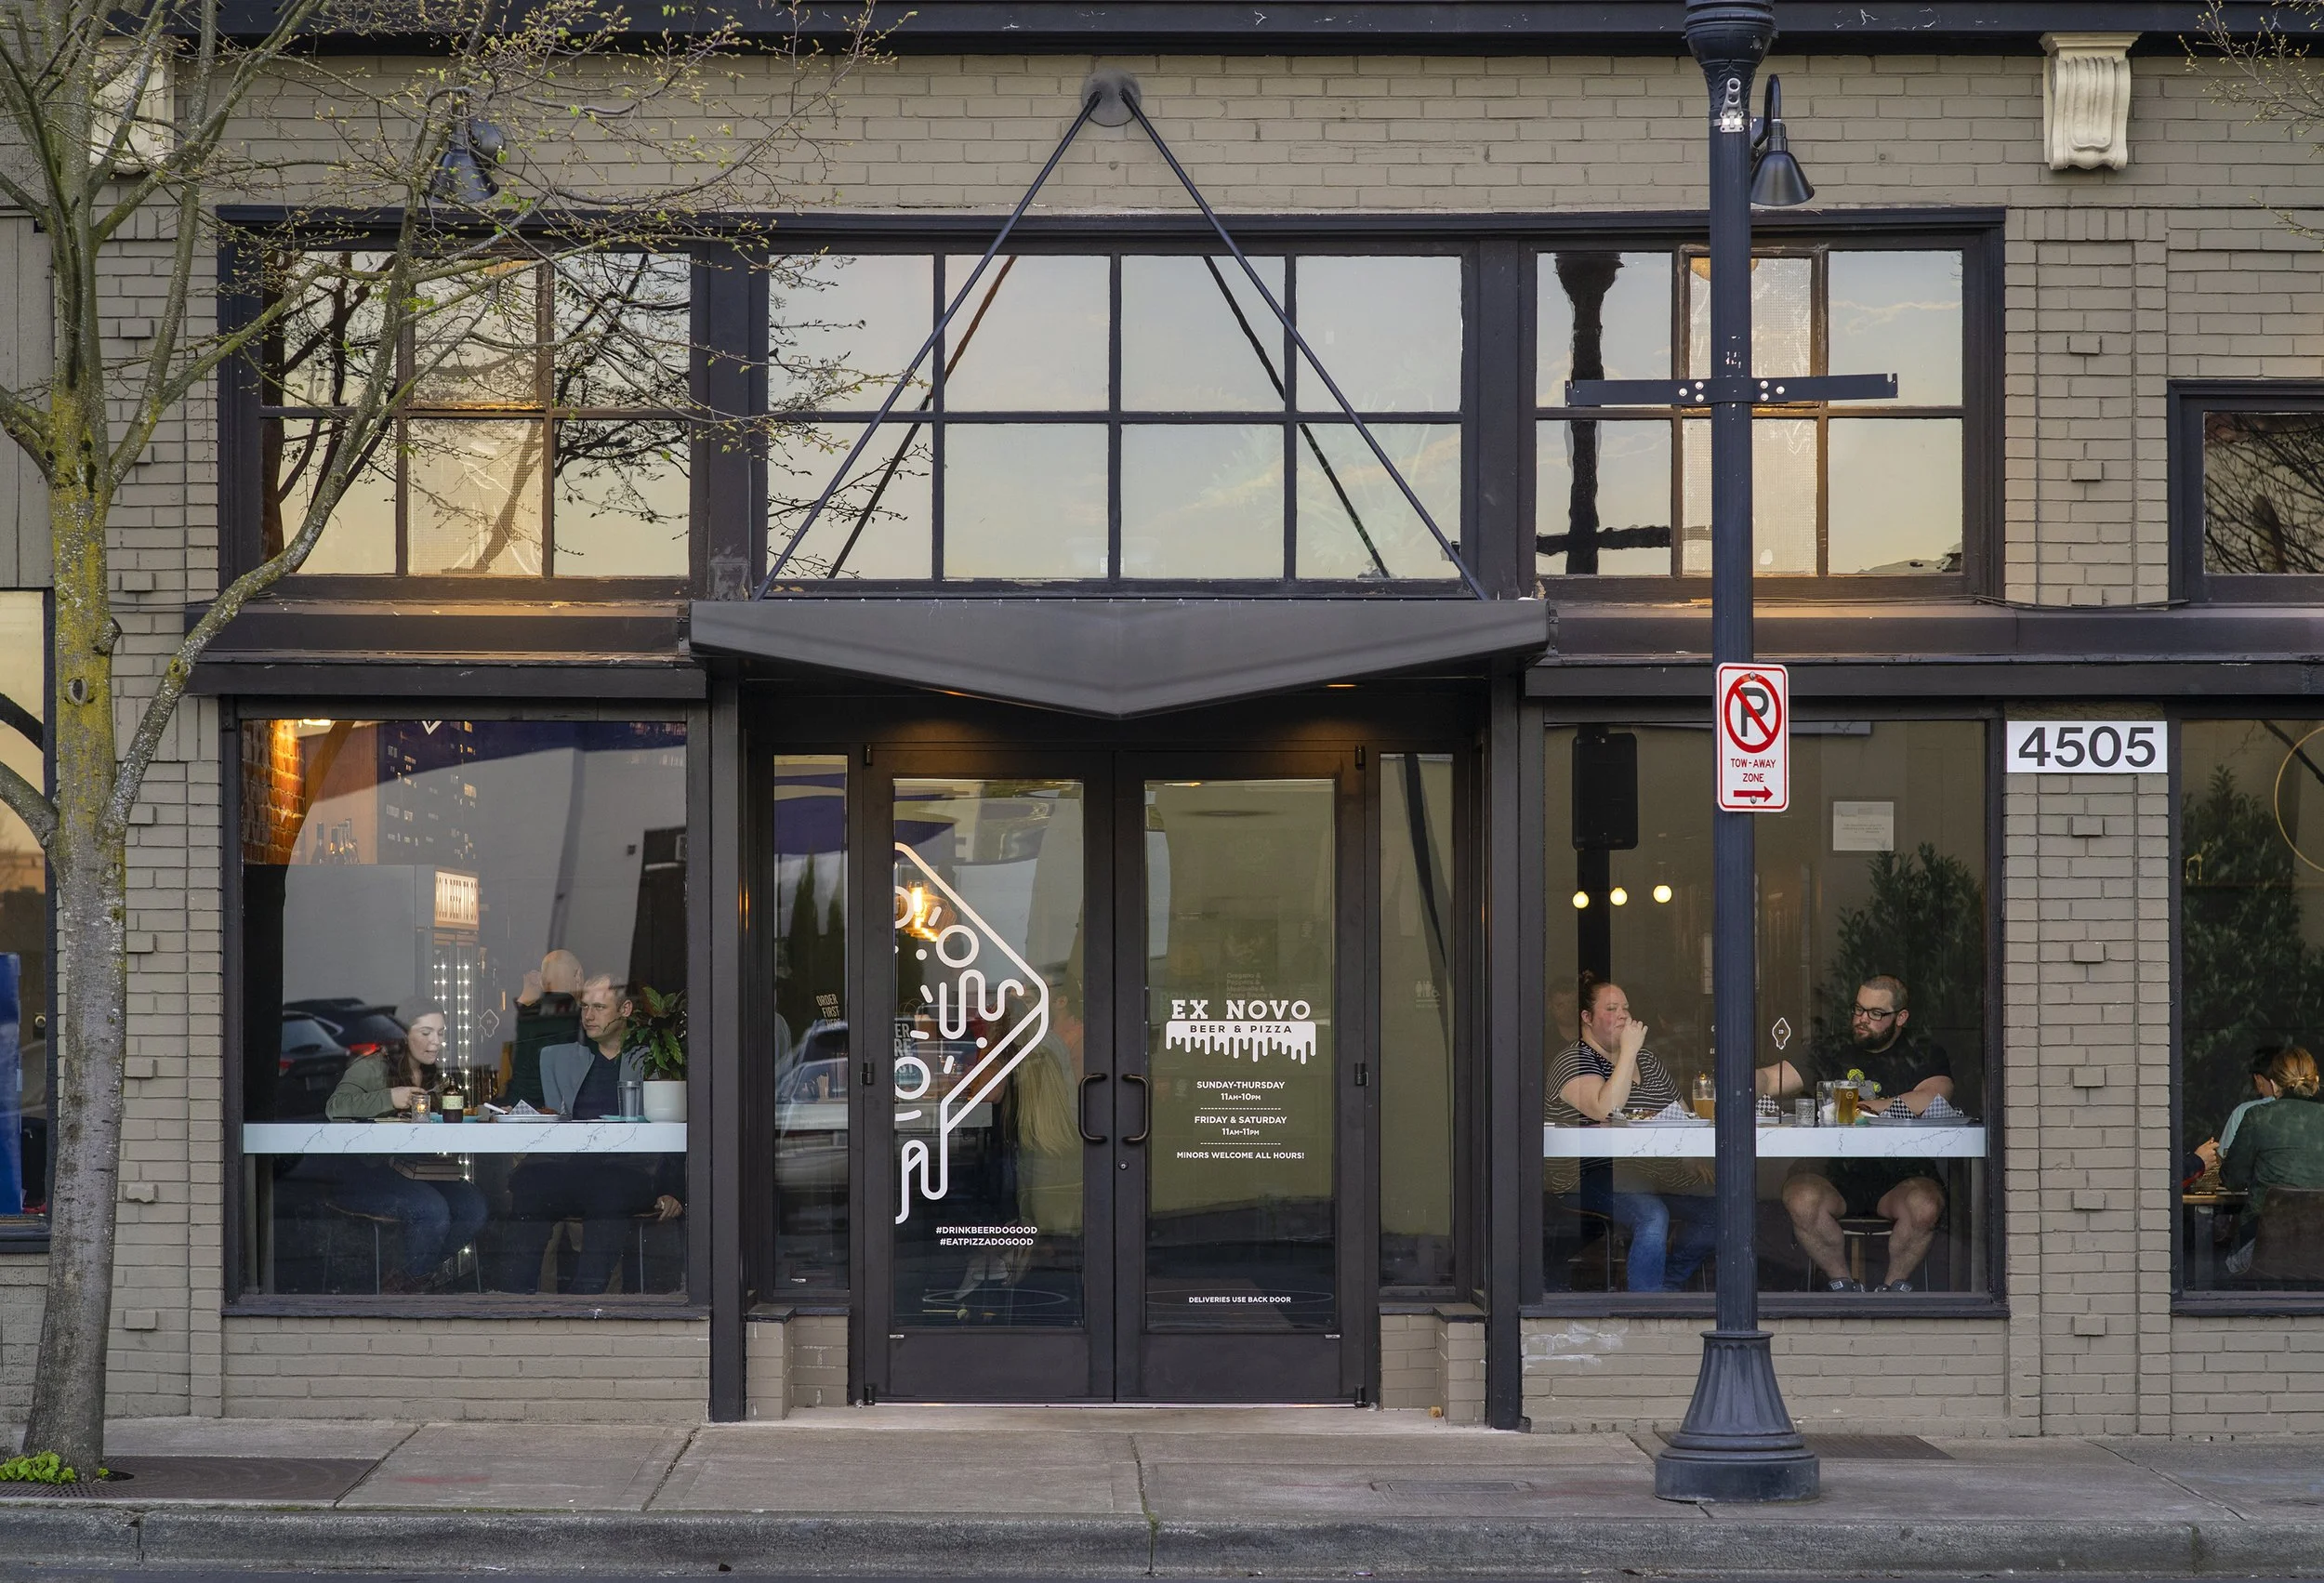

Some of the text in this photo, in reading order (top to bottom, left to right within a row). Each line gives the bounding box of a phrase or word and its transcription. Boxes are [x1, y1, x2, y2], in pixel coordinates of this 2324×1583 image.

[2018, 726, 2156, 768] 4505
[1742, 773, 1764, 783] ZONE
[815, 994, 838, 1007] ORDER
[821, 1006, 840, 1018] FIRST
[1171, 1000, 1311, 1020] EX NOVO
[1190, 1025, 1292, 1034] BEER & PIZZA
[1196, 1081, 1286, 1089] SUNDAY-THURSDAY
[1177, 1151, 1305, 1159] MINORS WELCOME ALL HOURS!
[935, 1226, 1038, 1234] #DRINKBEERDOGOOD
